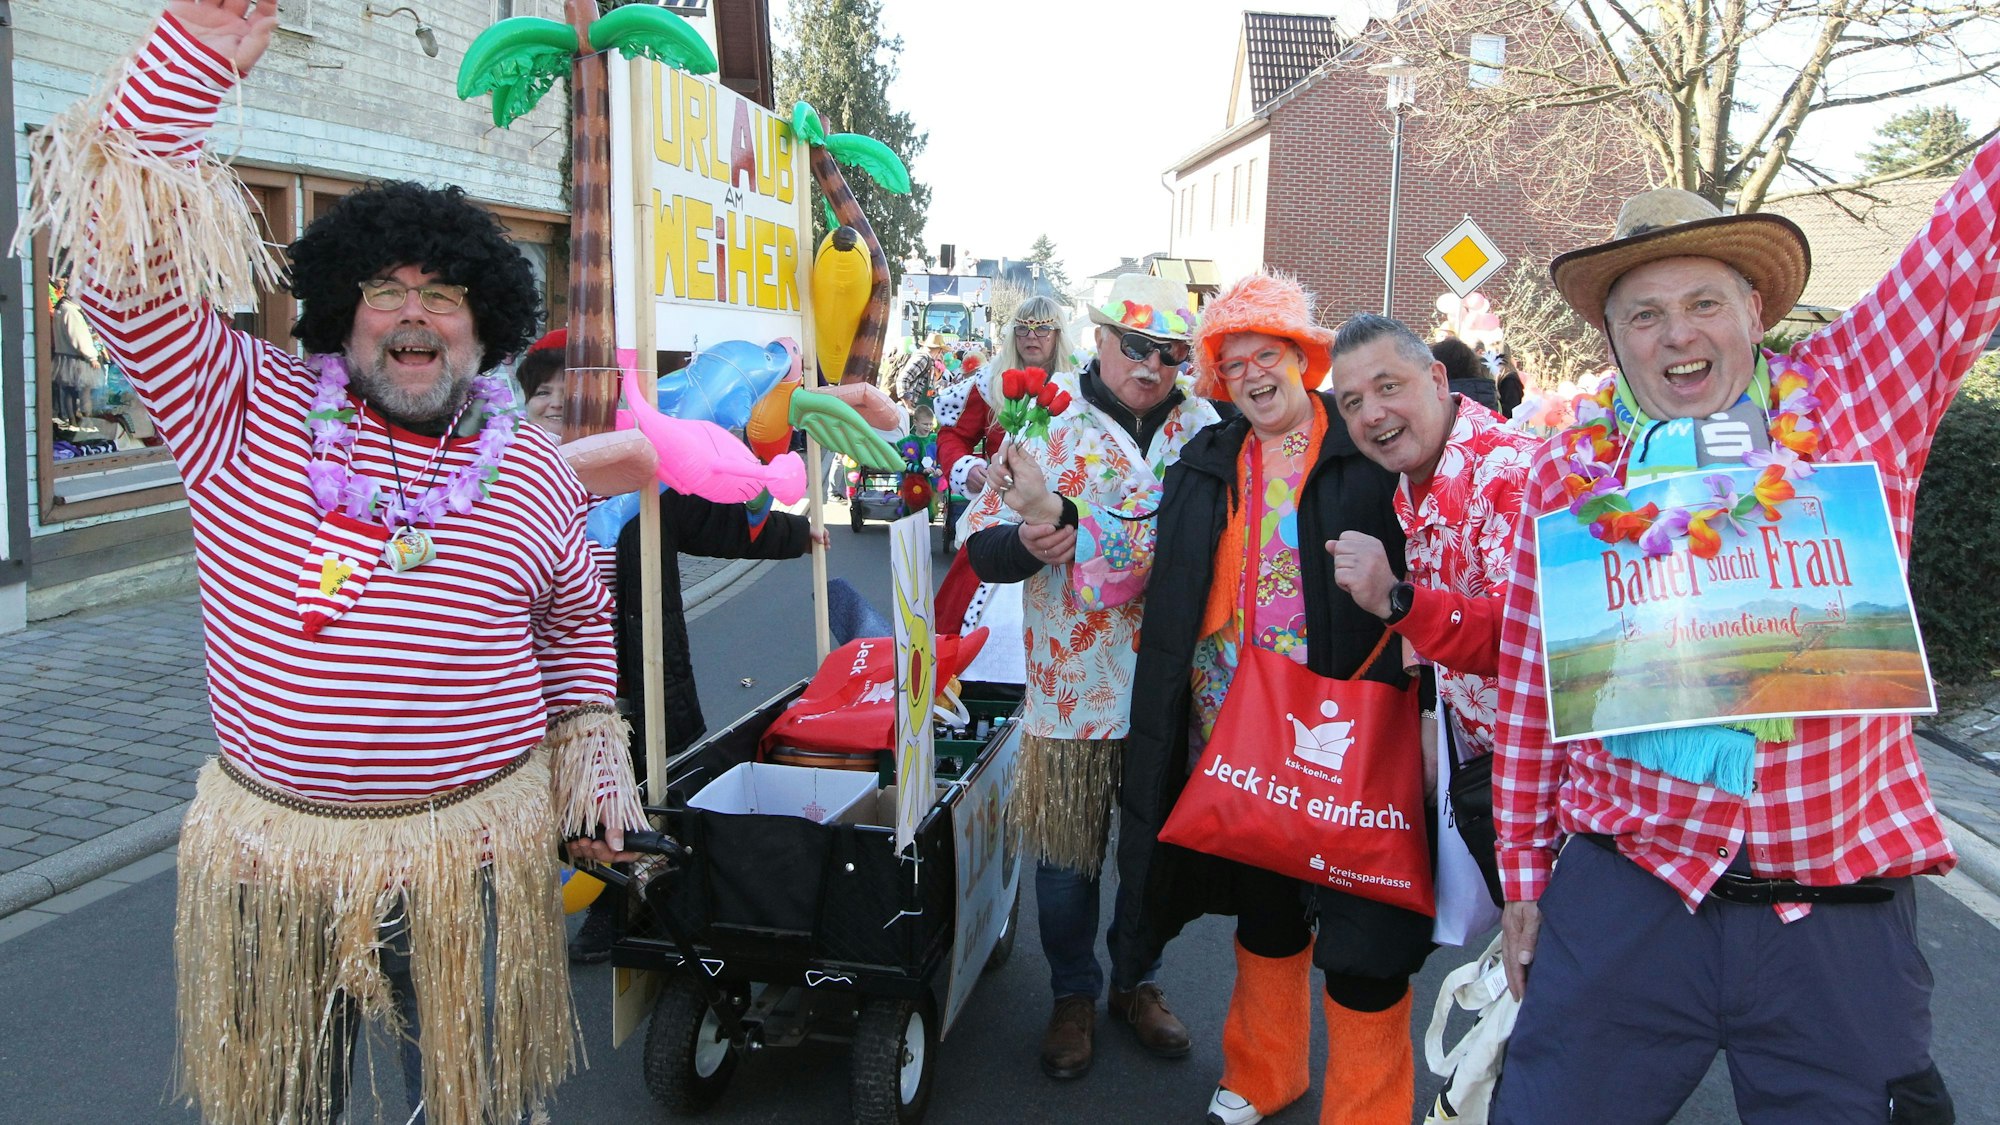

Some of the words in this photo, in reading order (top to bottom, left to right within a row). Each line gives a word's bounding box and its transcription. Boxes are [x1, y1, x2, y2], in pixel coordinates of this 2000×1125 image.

[652, 60, 794, 204] URLAUB
[724, 187, 743, 211] AM
[1708, 546, 1759, 582] sucht
[1758, 525, 1853, 589] Frau
[1664, 607, 1802, 649] International
[850, 641, 874, 676] Jeck
[1285, 757, 1343, 785] ksk-koeln.de
[1204, 754, 1263, 795] Jeck
[1266, 775, 1301, 810] ist
[1306, 795, 1411, 831] einfach.
[1328, 875, 1353, 888] Köln
[1329, 865, 1412, 889] Kreissparkasse
